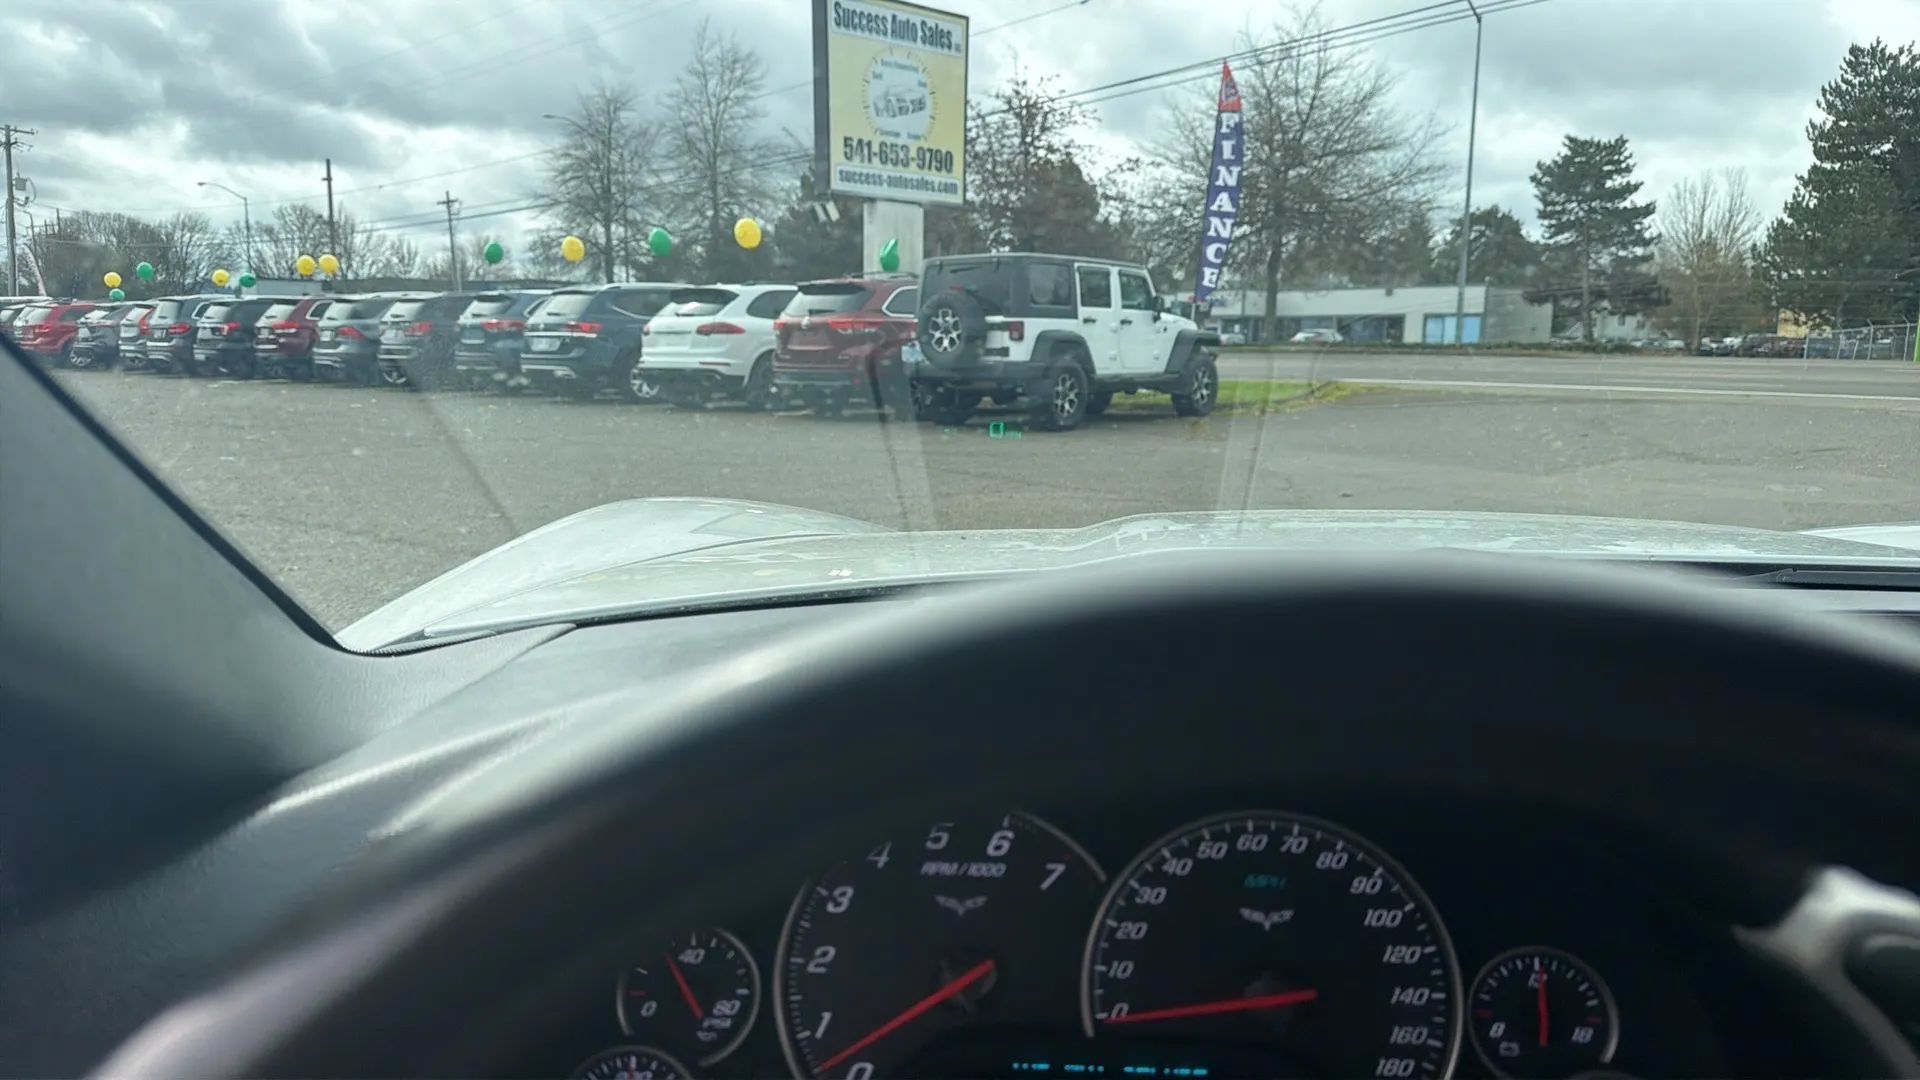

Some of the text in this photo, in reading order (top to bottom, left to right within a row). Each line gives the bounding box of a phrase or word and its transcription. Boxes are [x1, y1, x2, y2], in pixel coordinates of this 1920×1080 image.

[834, 2, 953, 50] Success Auto Sales
[843, 136, 954, 174] 541-653-9790
[838, 169, 958, 195] success-autosales.com
[1202, 112, 1242, 288] FINANCE
[925, 823, 954, 850] 5
[986, 830, 1015, 857] 6
[1236, 834, 1269, 852] 60
[1280, 836, 1308, 854] 70
[867, 841, 892, 869] 4
[1196, 842, 1228, 860] 50
[1162, 858, 1193, 876] 40
[1316, 852, 1348, 870] 80
[1040, 863, 1065, 890] 7
[1350, 876, 1383, 895] 90
[826, 886, 853, 914] 3
[1135, 887, 1167, 905] 30
[1364, 908, 1401, 928] 100
[1116, 922, 1147, 940] 20
[806, 945, 836, 973] 2
[1383, 945, 1422, 964] 120
[1108, 961, 1134, 979] 10
[1391, 987, 1430, 1006] 140
[640, 1001, 657, 1017] 0
[815, 1012, 832, 1039] 1
[1389, 1026, 1428, 1045] 160
[1375, 1058, 1415, 1077] 180
